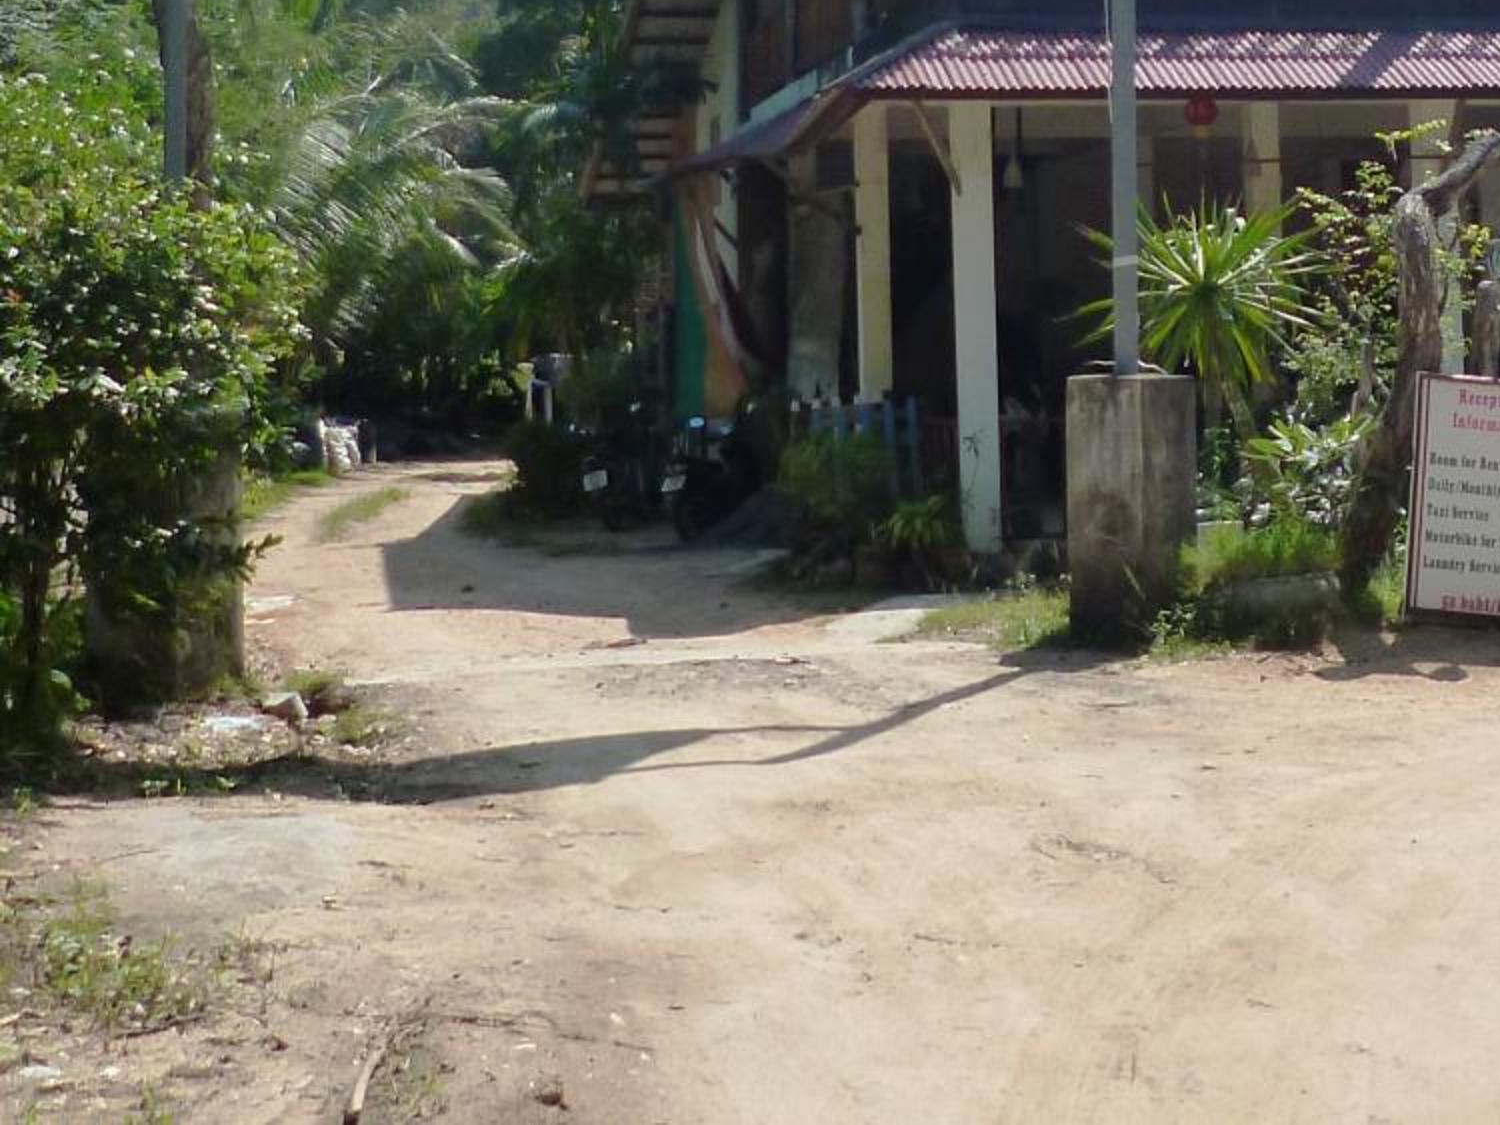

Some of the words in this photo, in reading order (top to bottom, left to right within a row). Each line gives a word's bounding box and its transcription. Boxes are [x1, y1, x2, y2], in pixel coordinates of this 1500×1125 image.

[1430, 452, 1458, 467] Room
[1461, 455, 1477, 469] for
[1427, 503, 1449, 518] Taxi
[1452, 505, 1489, 522] Service
[1425, 529, 1477, 547] Motorbike
[1480, 533, 1497, 548] for
[1423, 555, 1465, 572] Laundry
